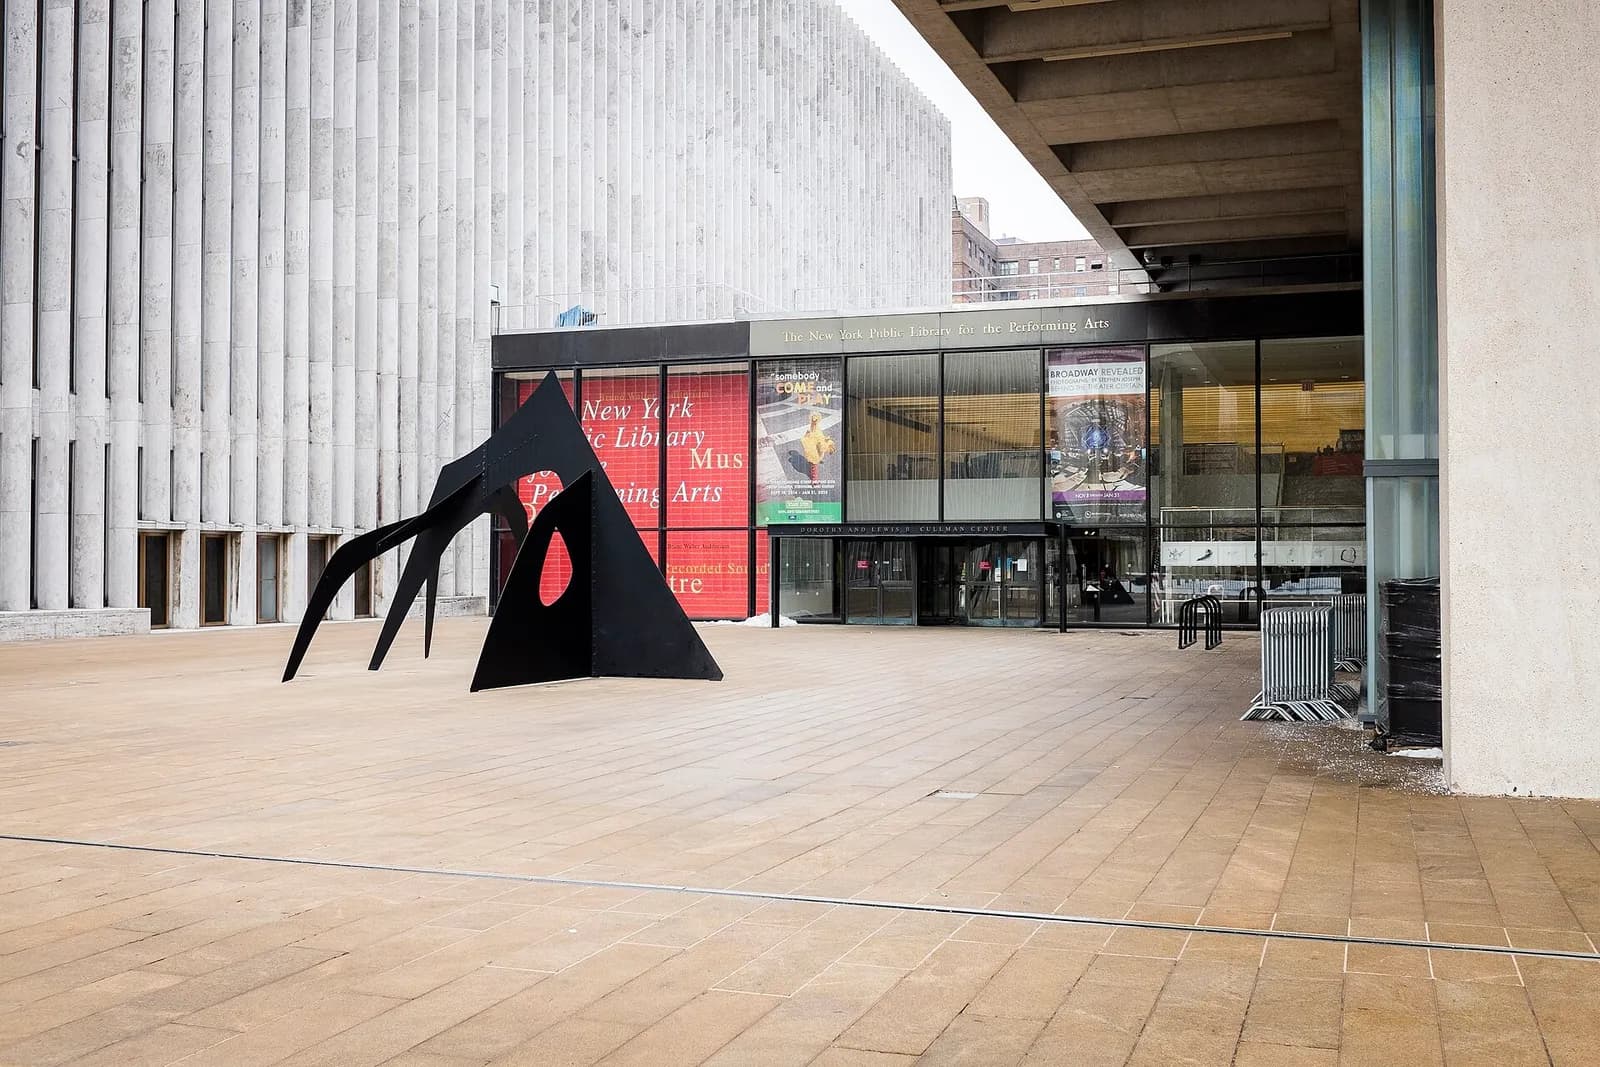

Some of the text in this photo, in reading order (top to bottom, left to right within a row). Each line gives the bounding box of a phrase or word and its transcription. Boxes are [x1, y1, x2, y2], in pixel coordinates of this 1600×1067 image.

[783, 318, 1110, 342] The New York Public Library for the Performing Arts
[1050, 367, 1144, 379] BROADWAY REVEALED
[776, 382, 833, 394] COME and
[798, 393, 831, 405] PLAY
[581, 400, 631, 421] New
[689, 447, 743, 469] Mus
[671, 480, 722, 503] Arts
